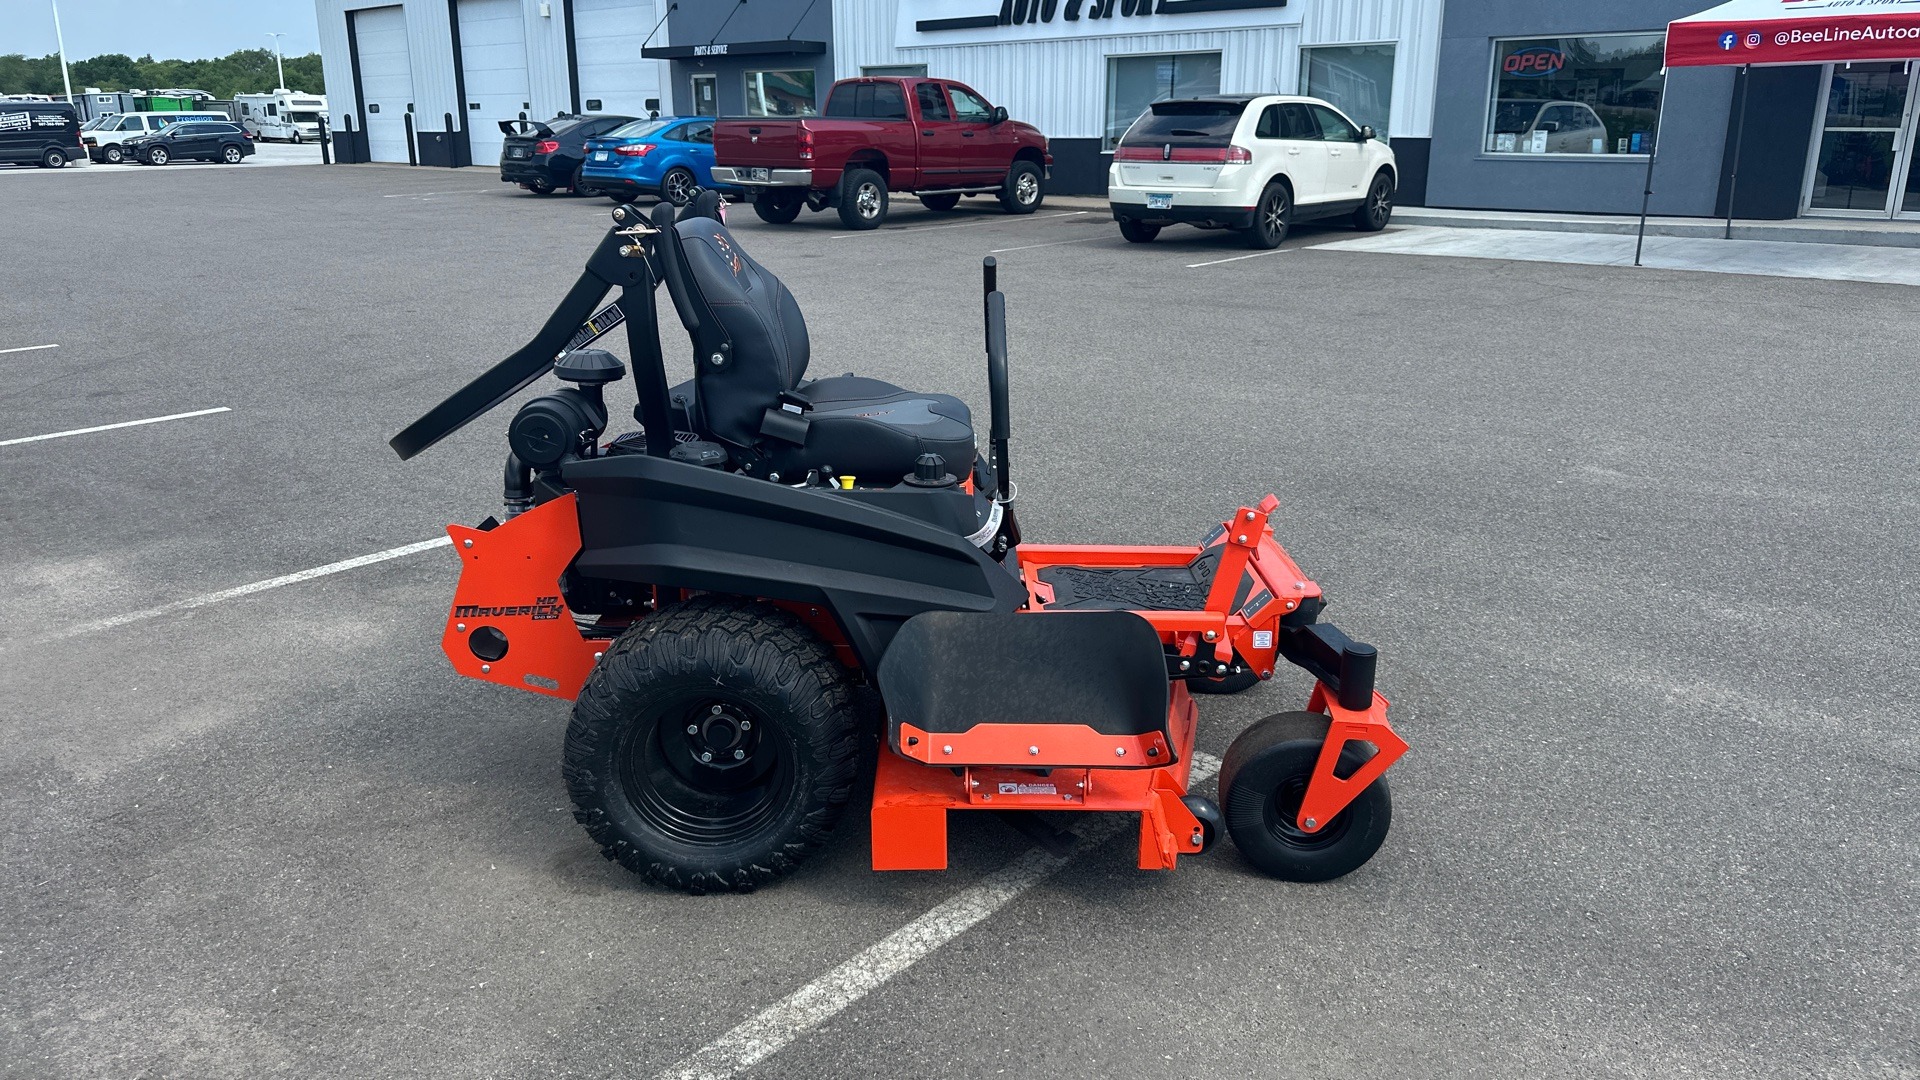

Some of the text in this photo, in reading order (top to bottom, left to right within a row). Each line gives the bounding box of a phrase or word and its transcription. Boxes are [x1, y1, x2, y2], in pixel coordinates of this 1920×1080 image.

[1774, 26, 1920, 46] @BeeLineAutoa
[694, 45, 707, 56] PARTS
[711, 44, 728, 54] SERVICE
[1503, 52, 1566, 72] OPEN
[175, 114, 213, 122] Precision
[536, 596, 558, 605] HD
